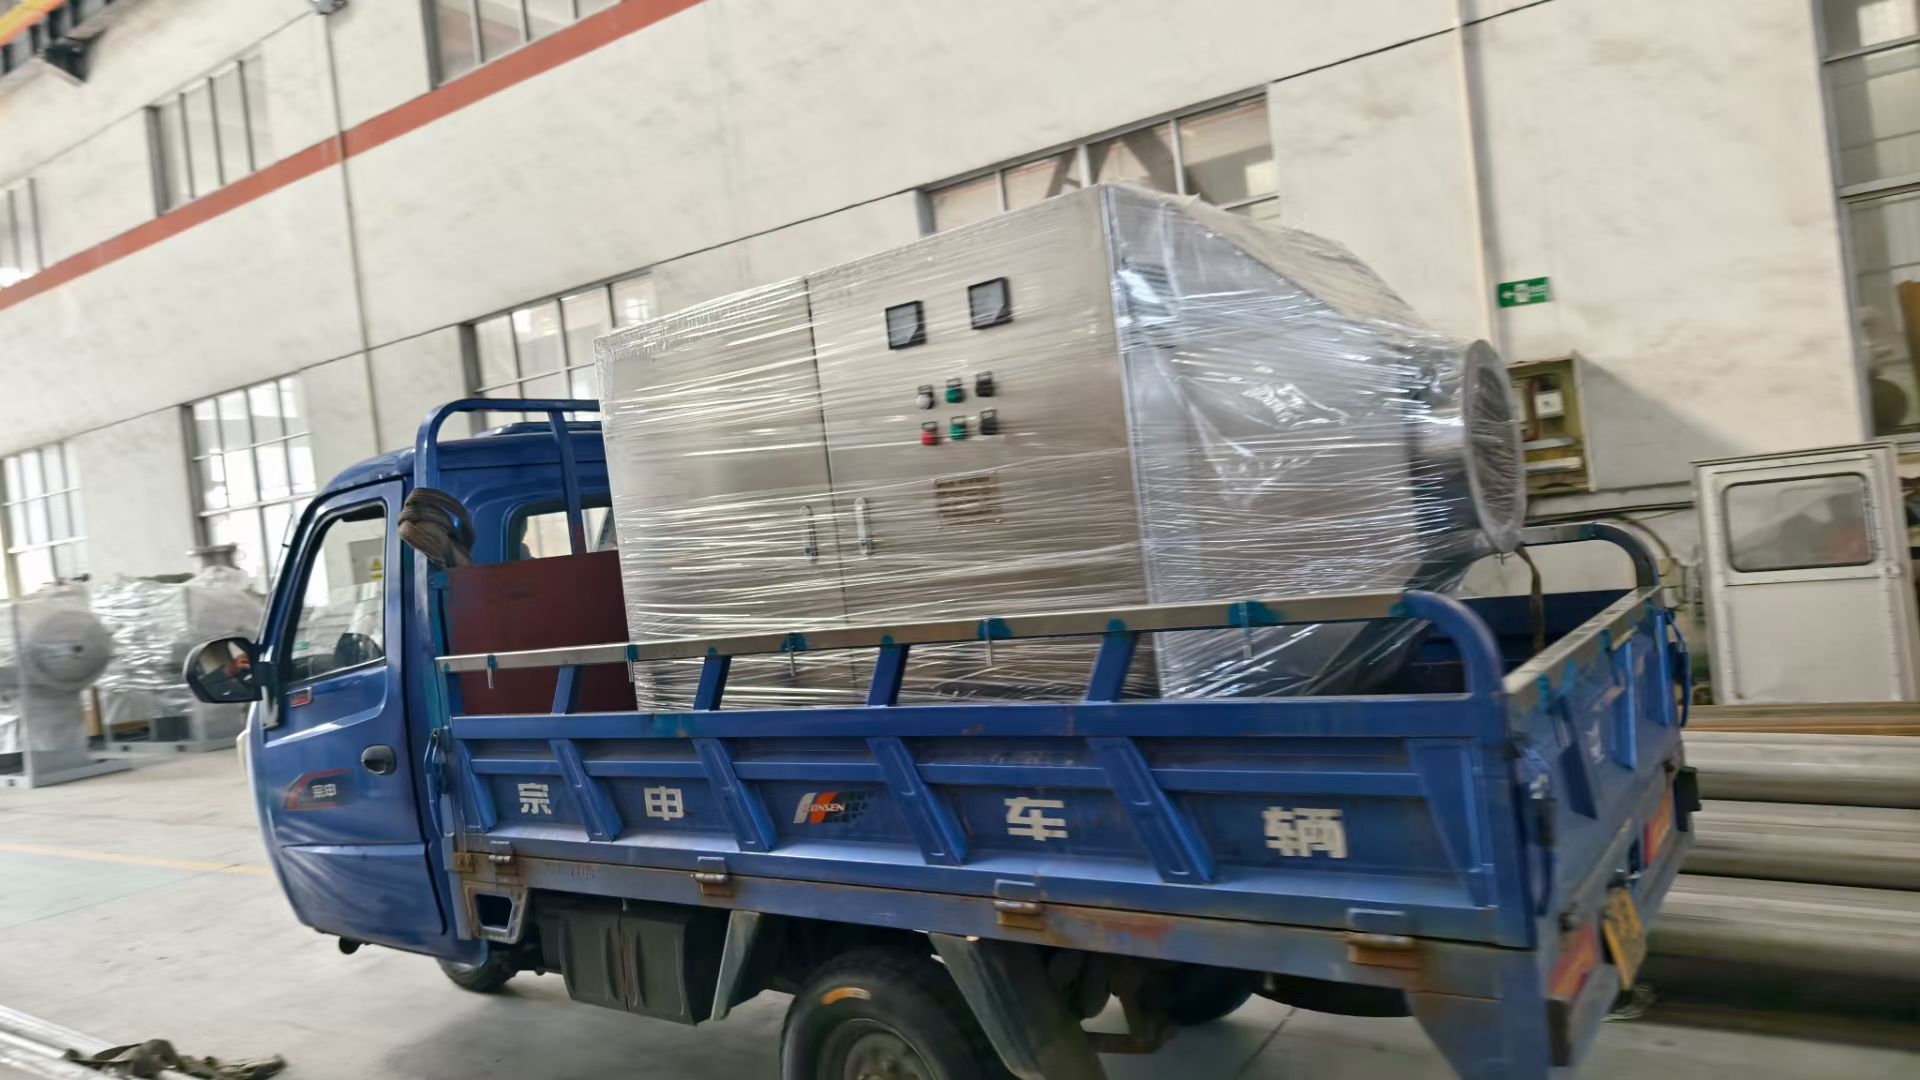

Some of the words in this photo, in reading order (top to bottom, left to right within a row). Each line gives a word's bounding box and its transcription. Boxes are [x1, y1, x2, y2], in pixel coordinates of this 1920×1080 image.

[517, 783, 552, 815] 宗
[643, 785, 684, 821] 申
[1003, 796, 1068, 841] 车
[1261, 806, 1347, 858] 辆
